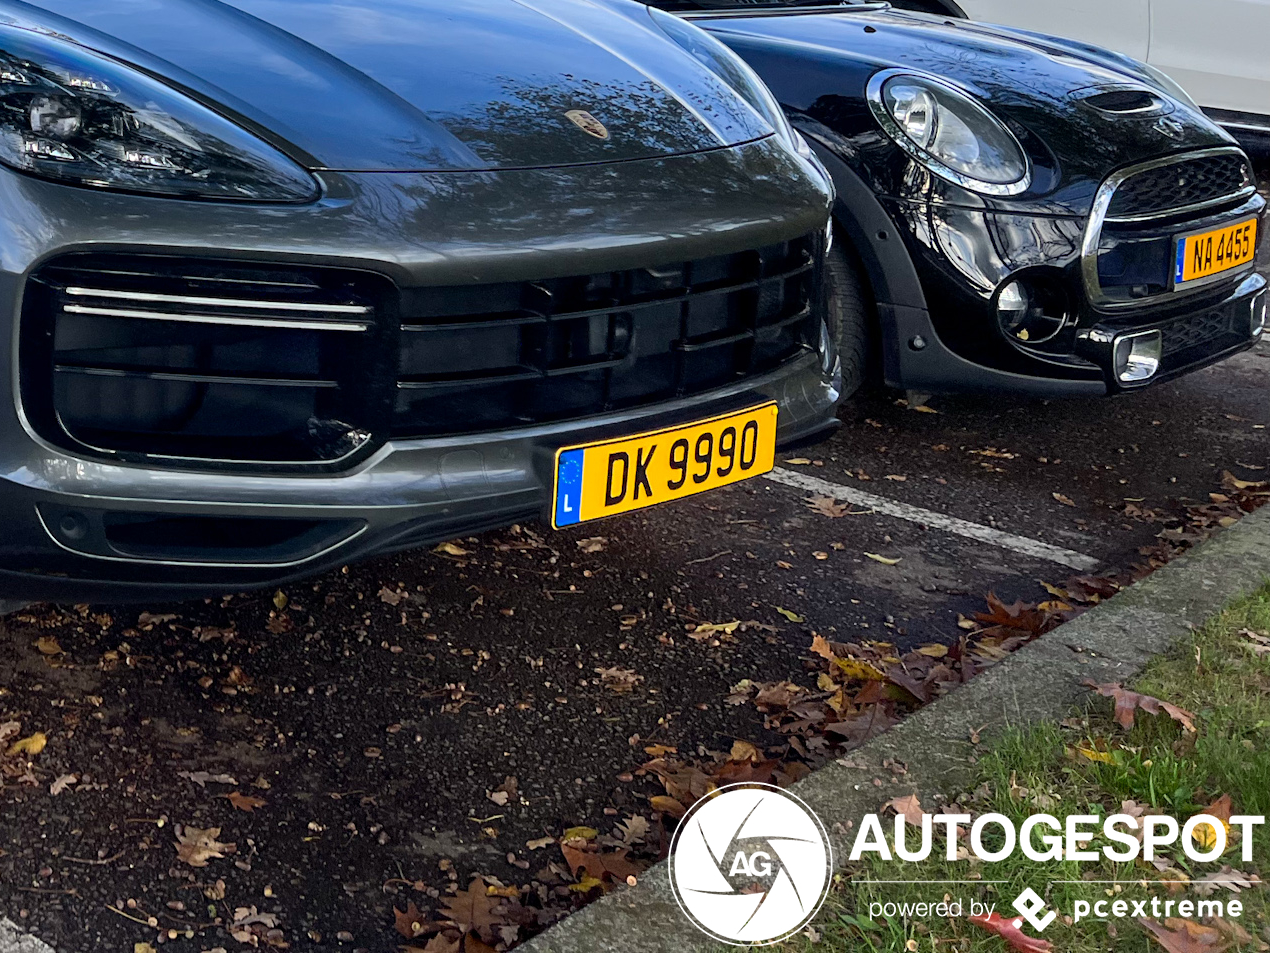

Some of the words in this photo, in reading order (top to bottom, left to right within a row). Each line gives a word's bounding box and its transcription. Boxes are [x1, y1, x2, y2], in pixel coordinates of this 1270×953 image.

[1193, 236, 1212, 274] NA
[1216, 225, 1250, 266] 4455
[604, 444, 657, 507] DK
[667, 420, 759, 491] 9990
[563, 494, 573, 513] L
